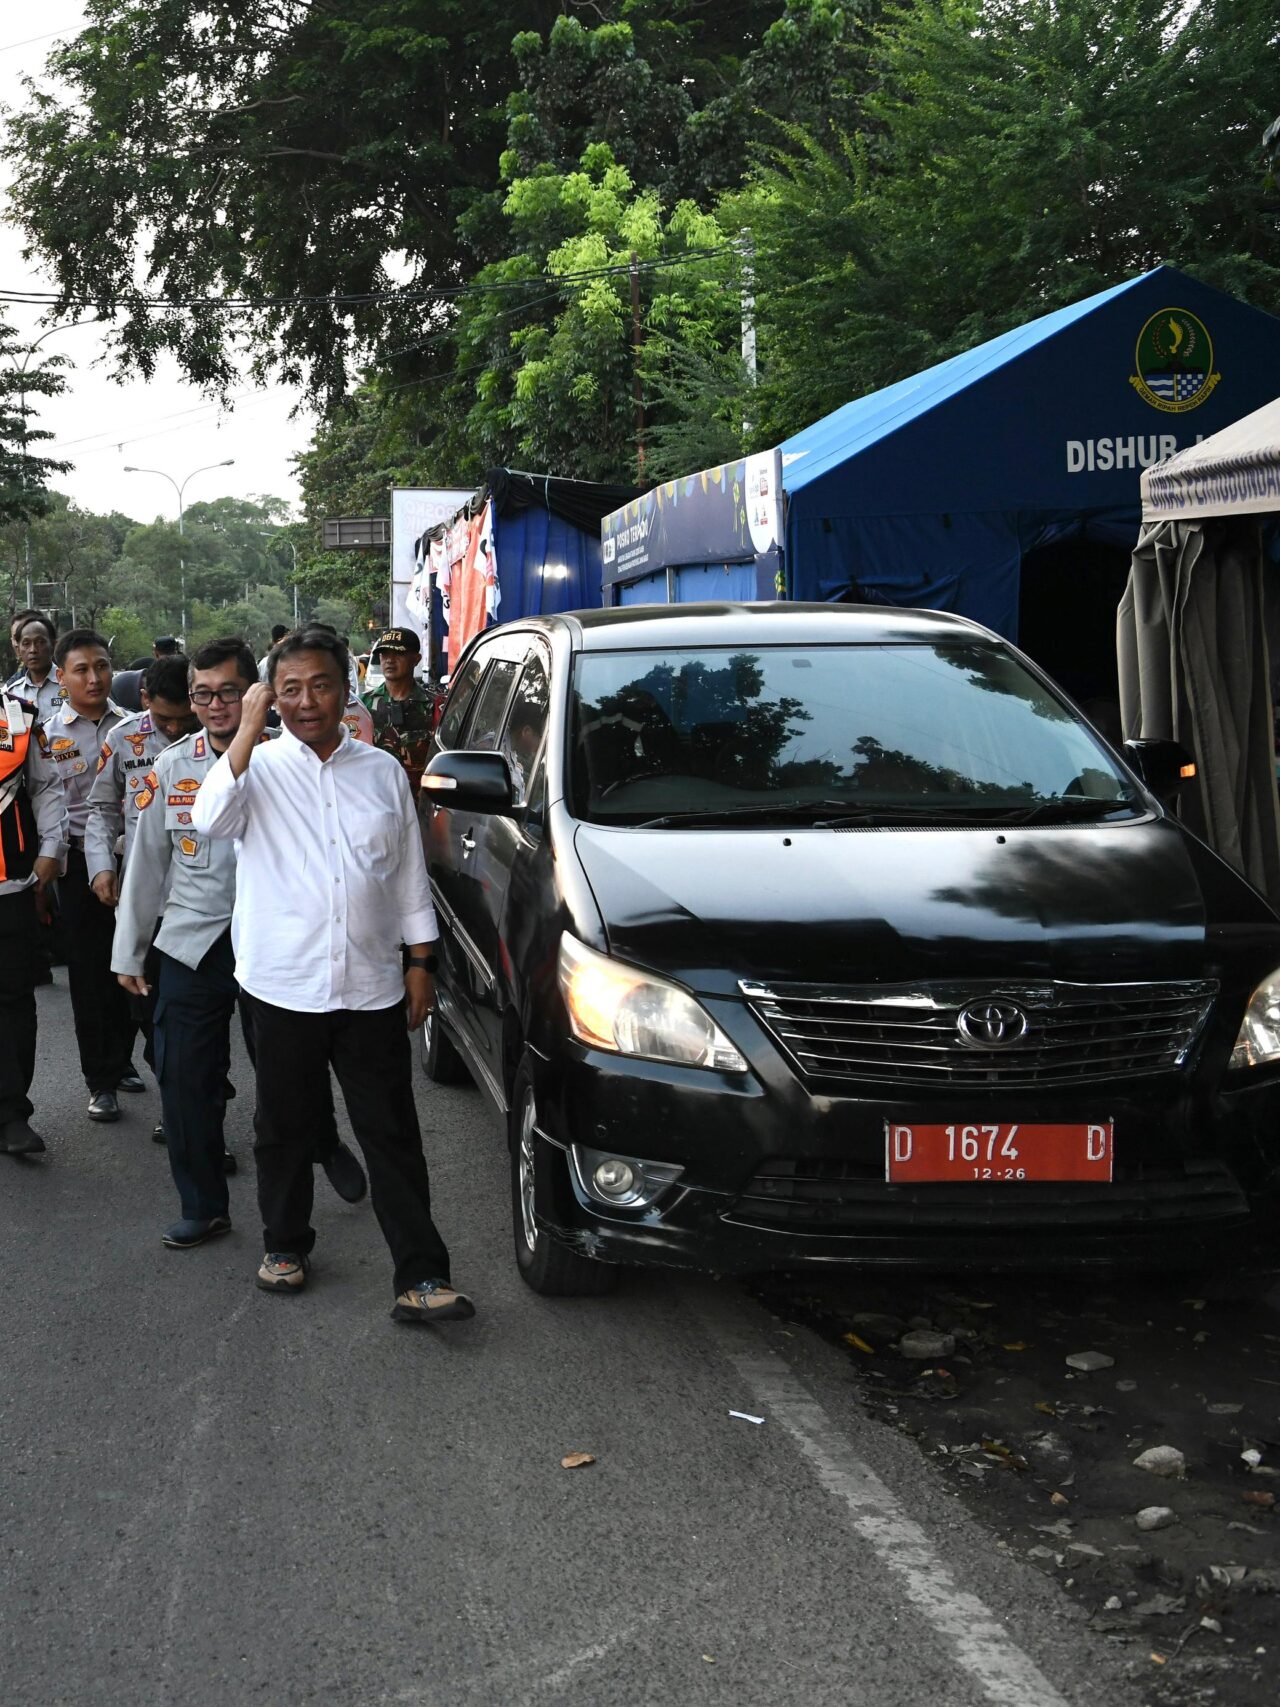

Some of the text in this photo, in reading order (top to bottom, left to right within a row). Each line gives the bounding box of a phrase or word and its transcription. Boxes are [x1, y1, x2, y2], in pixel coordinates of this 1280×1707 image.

[1066, 434, 1178, 473] DISHUB
[894, 1125, 1106, 1161] D 1674 D
